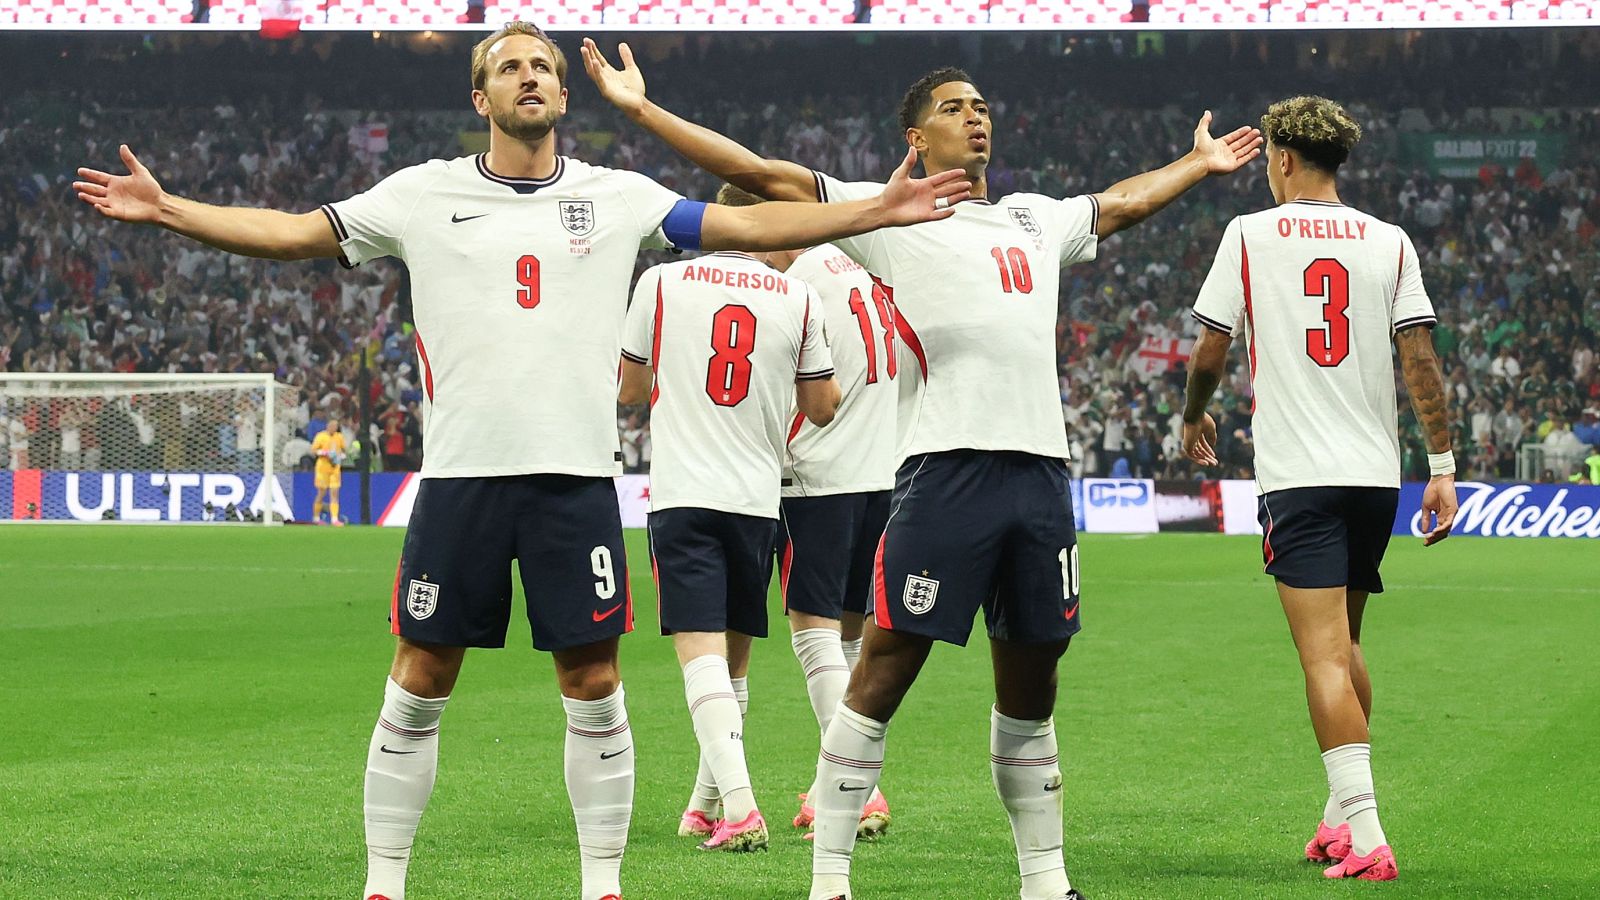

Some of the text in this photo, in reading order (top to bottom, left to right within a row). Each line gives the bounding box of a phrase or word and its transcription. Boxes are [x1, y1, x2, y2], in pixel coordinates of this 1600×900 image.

[1434, 139, 1537, 158] SALIDA EXIT 22
[569, 238, 591, 246] MEXICO
[1277, 217, 1366, 240] O'REILLY
[516, 254, 540, 309] 9
[682, 265, 789, 296] ANDERSON
[990, 246, 1033, 294] 10
[848, 283, 897, 386] 18
[1303, 258, 1350, 367] 3
[706, 303, 757, 407] 8
[66, 473, 296, 521] ULTRA
[590, 545, 616, 600] 9
[1058, 544, 1080, 600] 10
